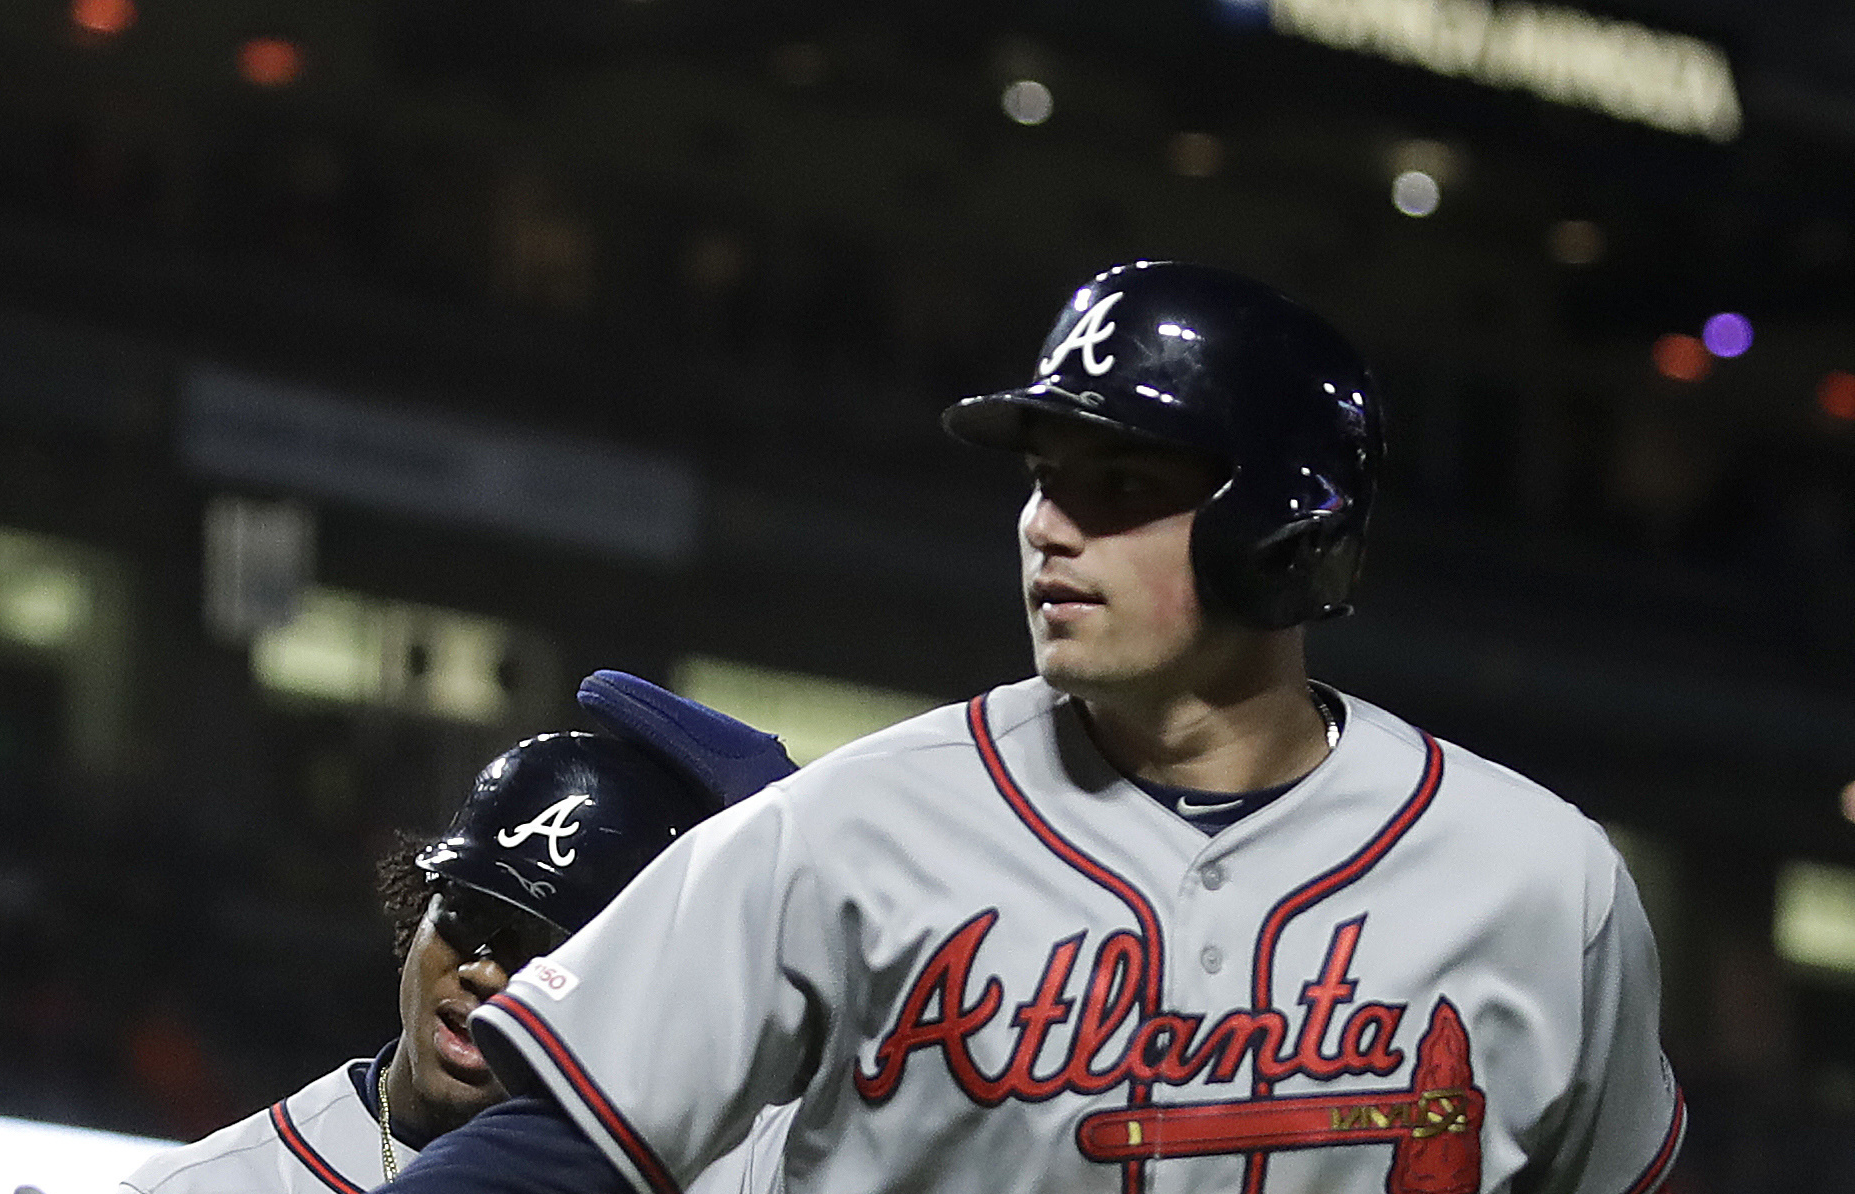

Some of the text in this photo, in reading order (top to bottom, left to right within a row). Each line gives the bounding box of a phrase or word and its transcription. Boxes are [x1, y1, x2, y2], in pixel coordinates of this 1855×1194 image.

[1041, 291, 1123, 376] A
[497, 794, 589, 867] A
[853, 908, 1409, 1109] Atlanta
